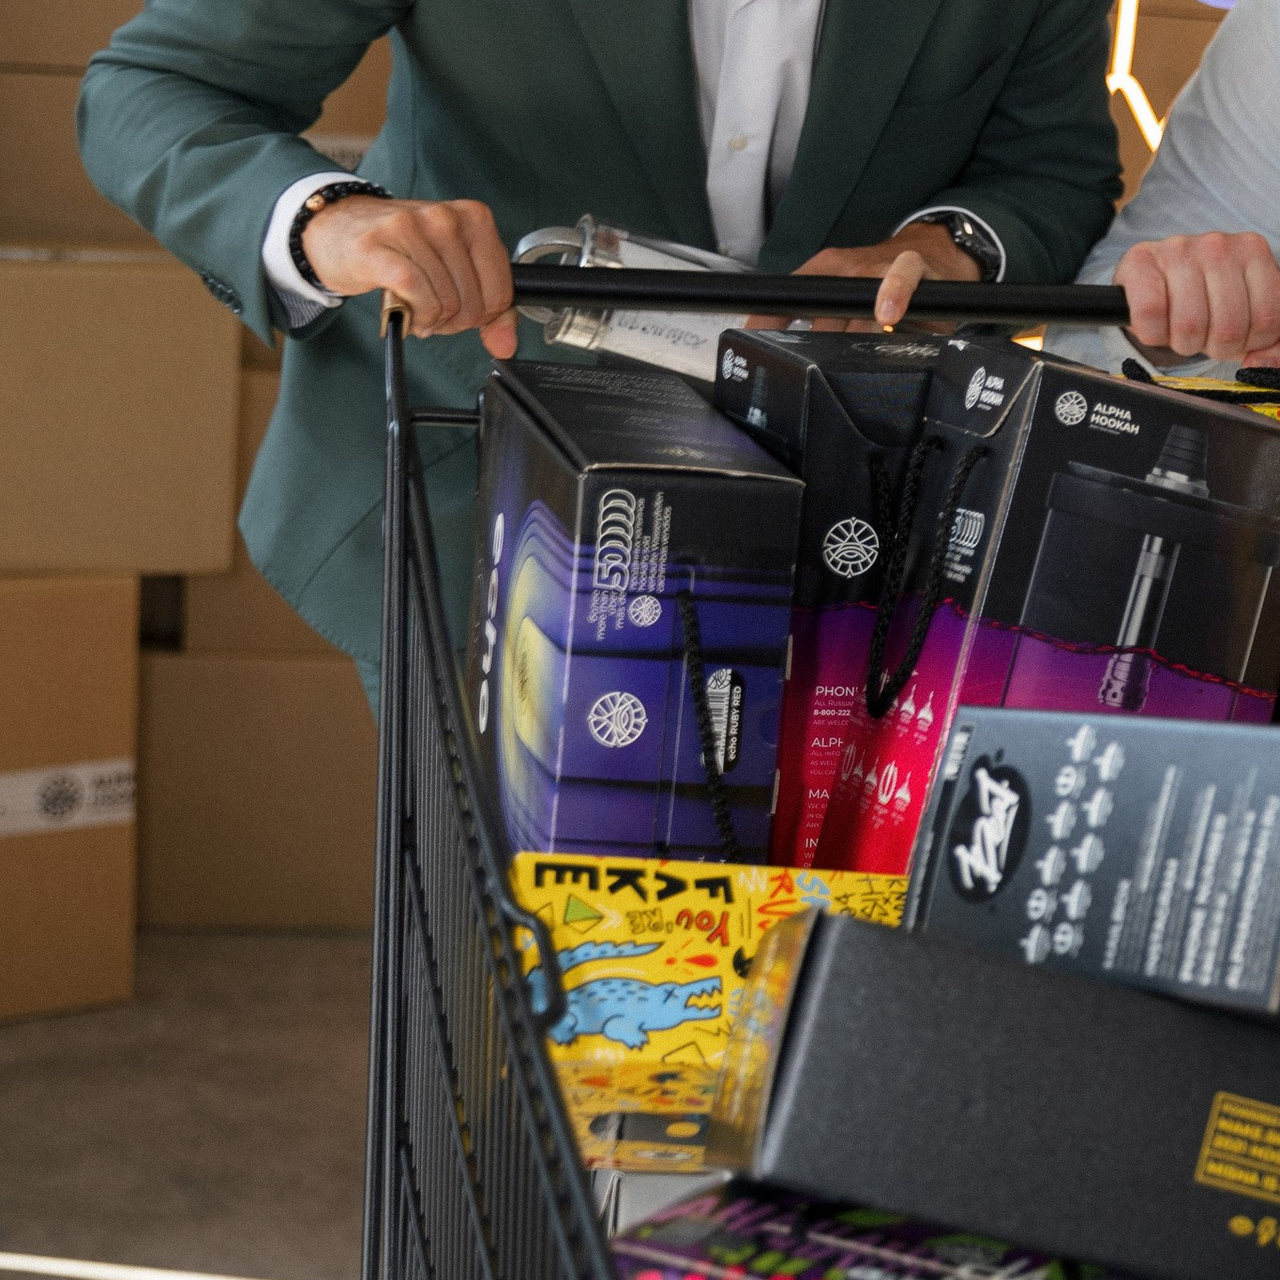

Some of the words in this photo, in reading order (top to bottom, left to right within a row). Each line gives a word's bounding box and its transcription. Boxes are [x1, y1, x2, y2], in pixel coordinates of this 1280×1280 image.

[1093, 402, 1132, 421] ALPHA
[1090, 413, 1140, 435] HOOKAH
[733, 685, 742, 707] RED
[815, 686, 858, 697] PHON
[730, 708, 741, 735] RUBY
[728, 735, 738, 761] echo
[534, 862, 735, 905] FAKE
